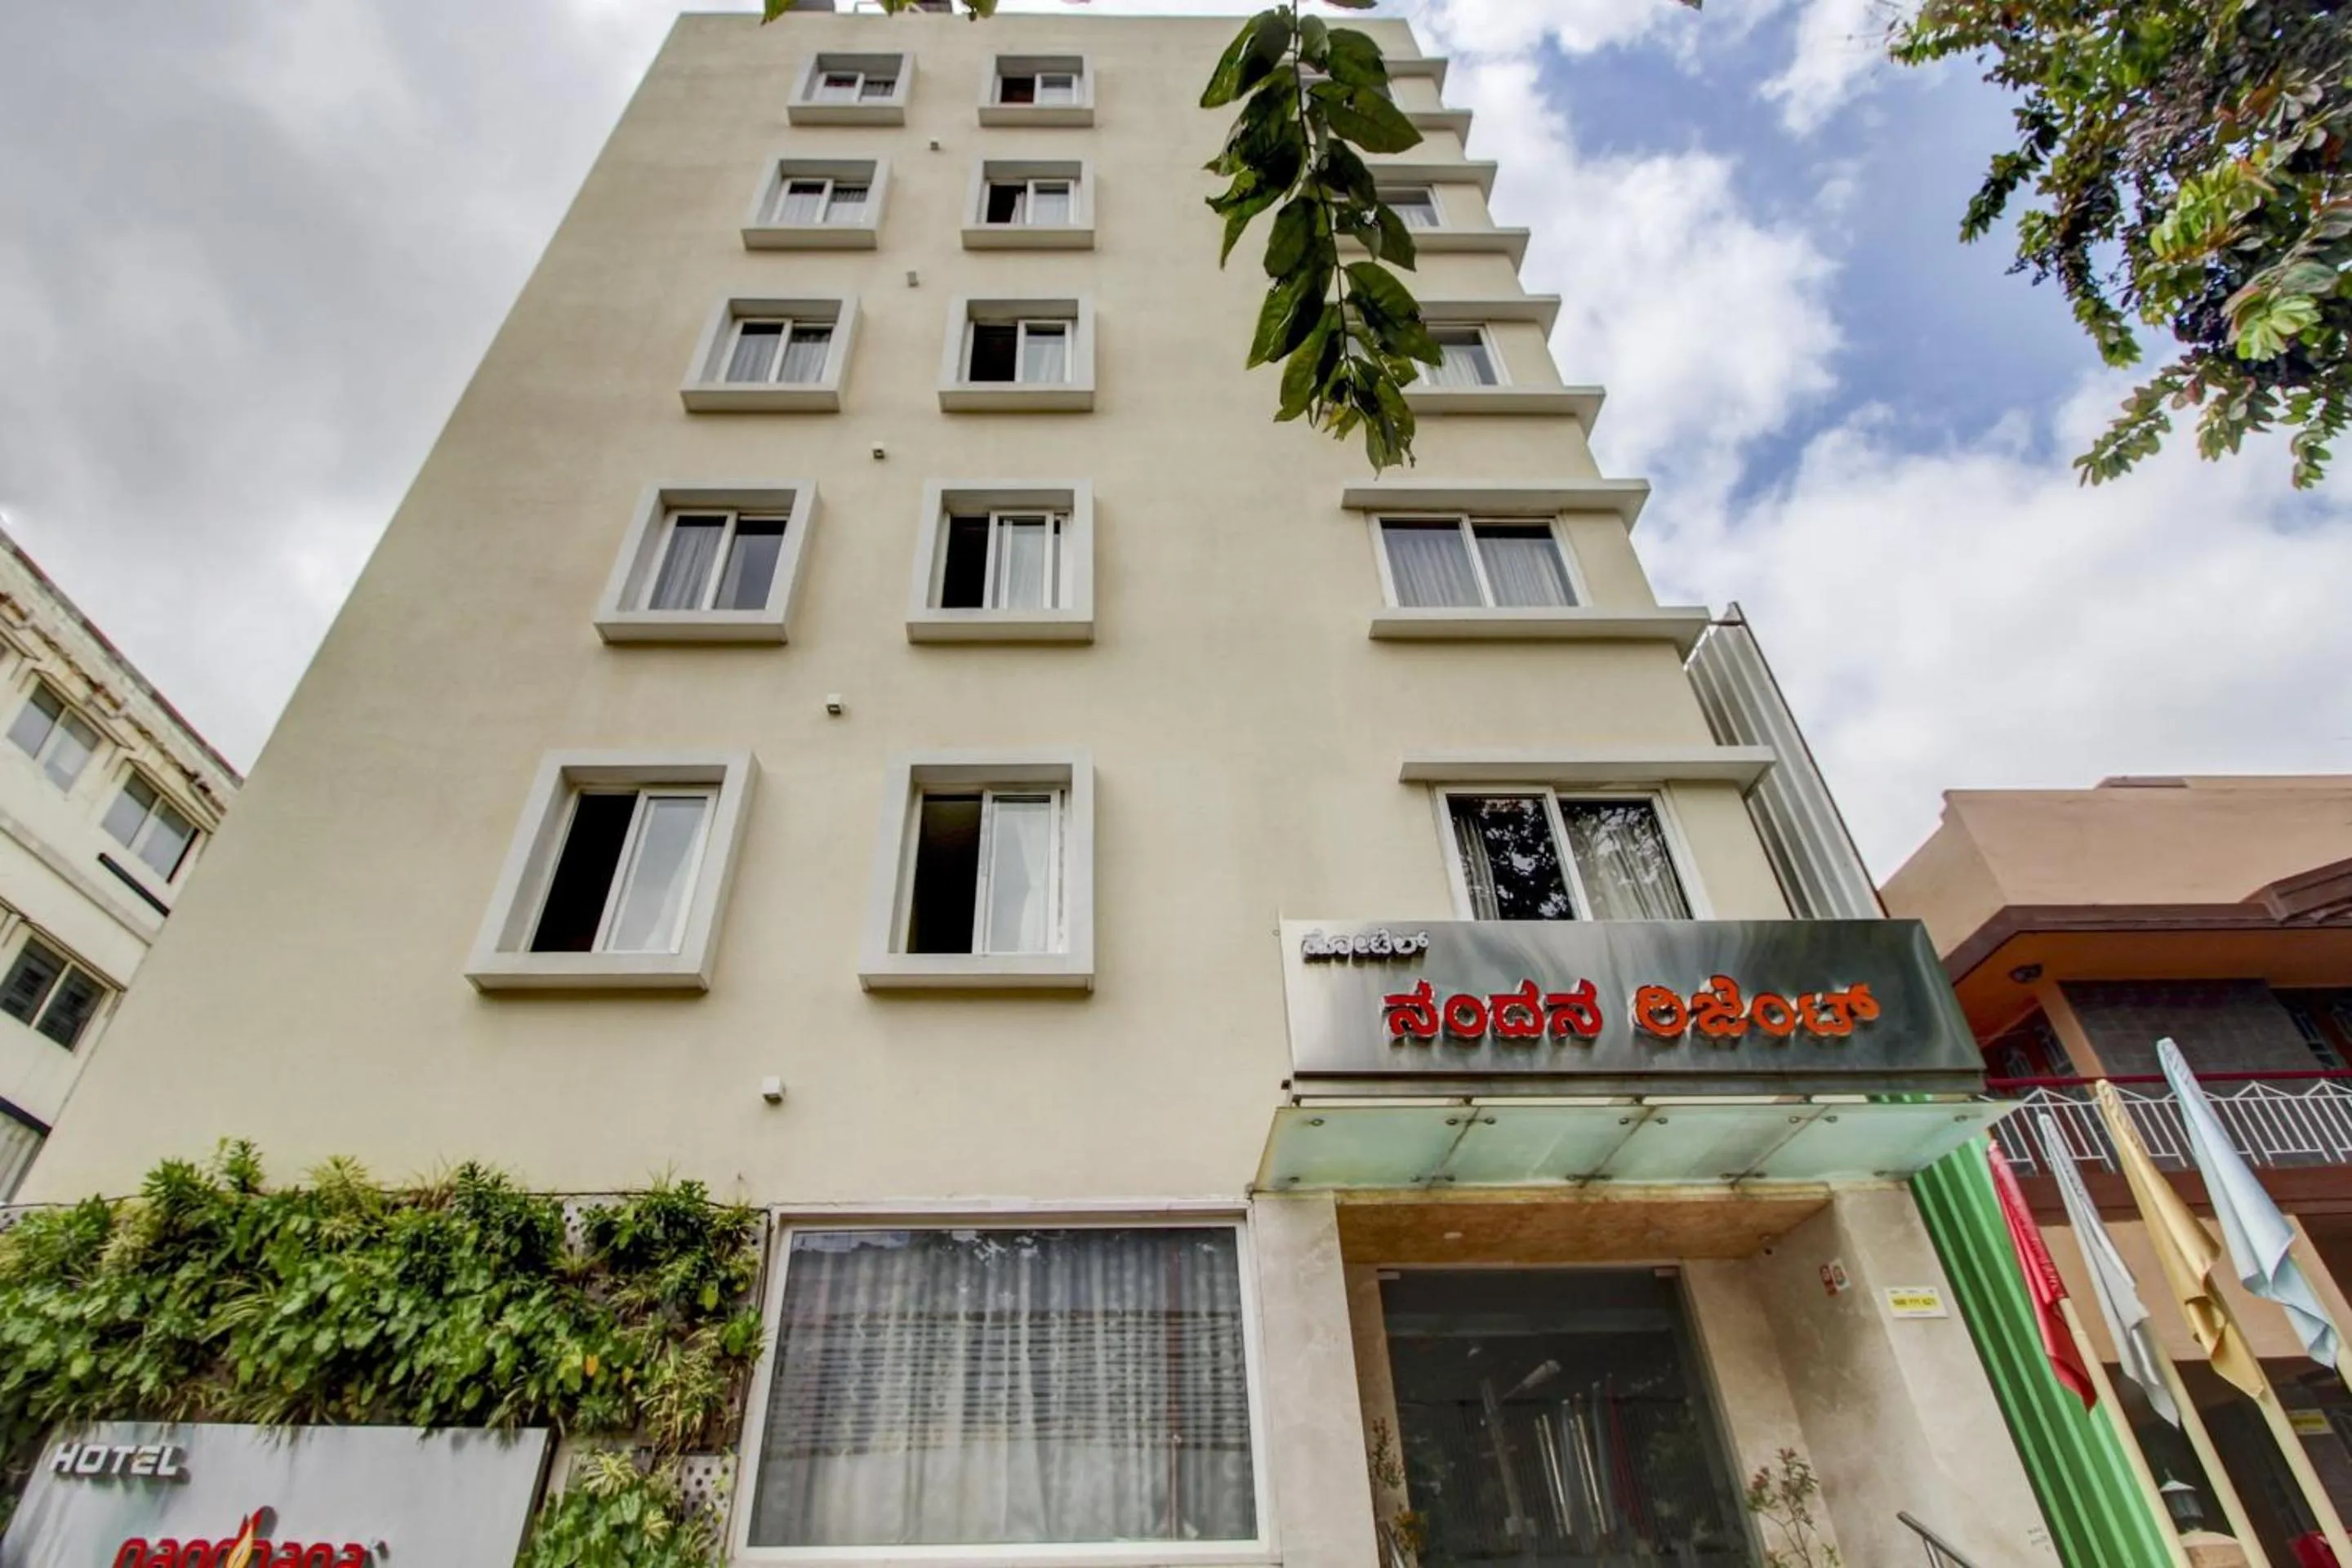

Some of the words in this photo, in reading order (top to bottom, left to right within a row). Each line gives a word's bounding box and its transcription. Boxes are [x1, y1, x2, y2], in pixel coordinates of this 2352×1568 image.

[1383, 978, 1603, 1039] ನಂದನ
[1632, 974, 1880, 1038] ರಿಜೆಂಟ್
[49, 1442, 179, 1476] HOTEL
